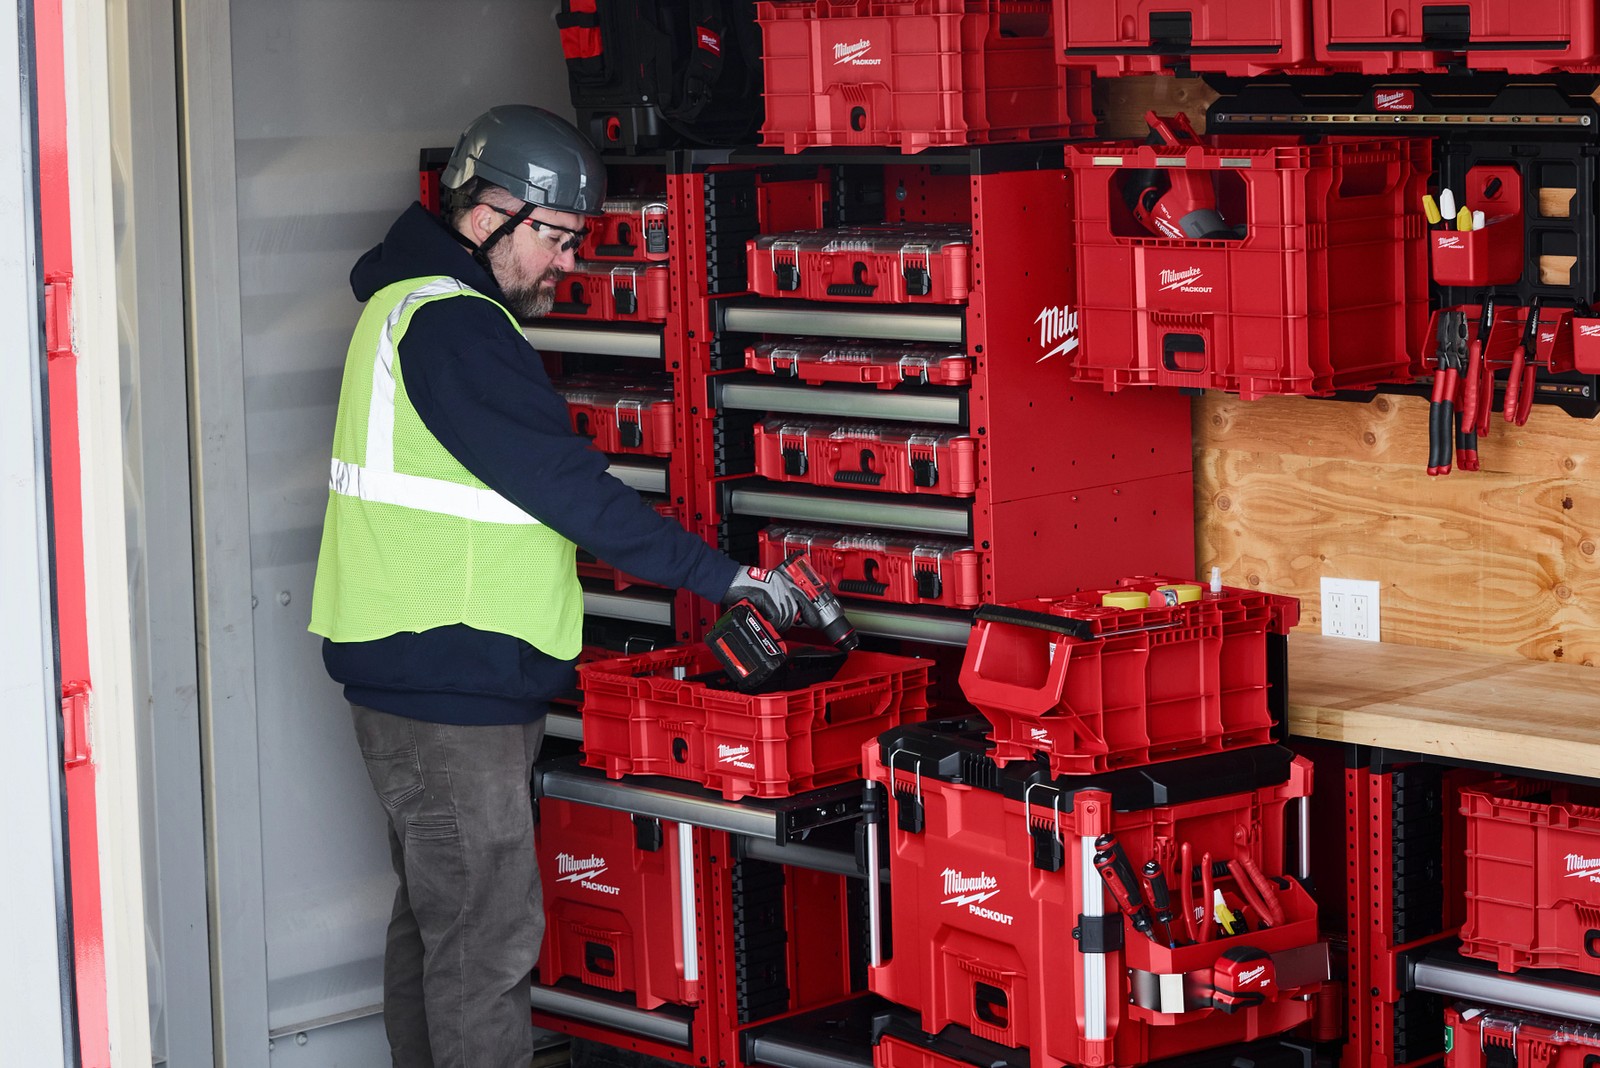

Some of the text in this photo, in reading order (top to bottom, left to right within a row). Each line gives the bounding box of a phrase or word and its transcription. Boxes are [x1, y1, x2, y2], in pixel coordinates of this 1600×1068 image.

[832, 39, 871, 60] Milwaukee
[1159, 266, 1202, 286] Milwaukee
[717, 744, 750, 758] Milwaukee
[555, 852, 606, 874] Milwaukee
[581, 880, 620, 895] PACKOUT
[940, 867, 998, 896] Milwaukee
[969, 904, 1014, 926] PACKOUT
